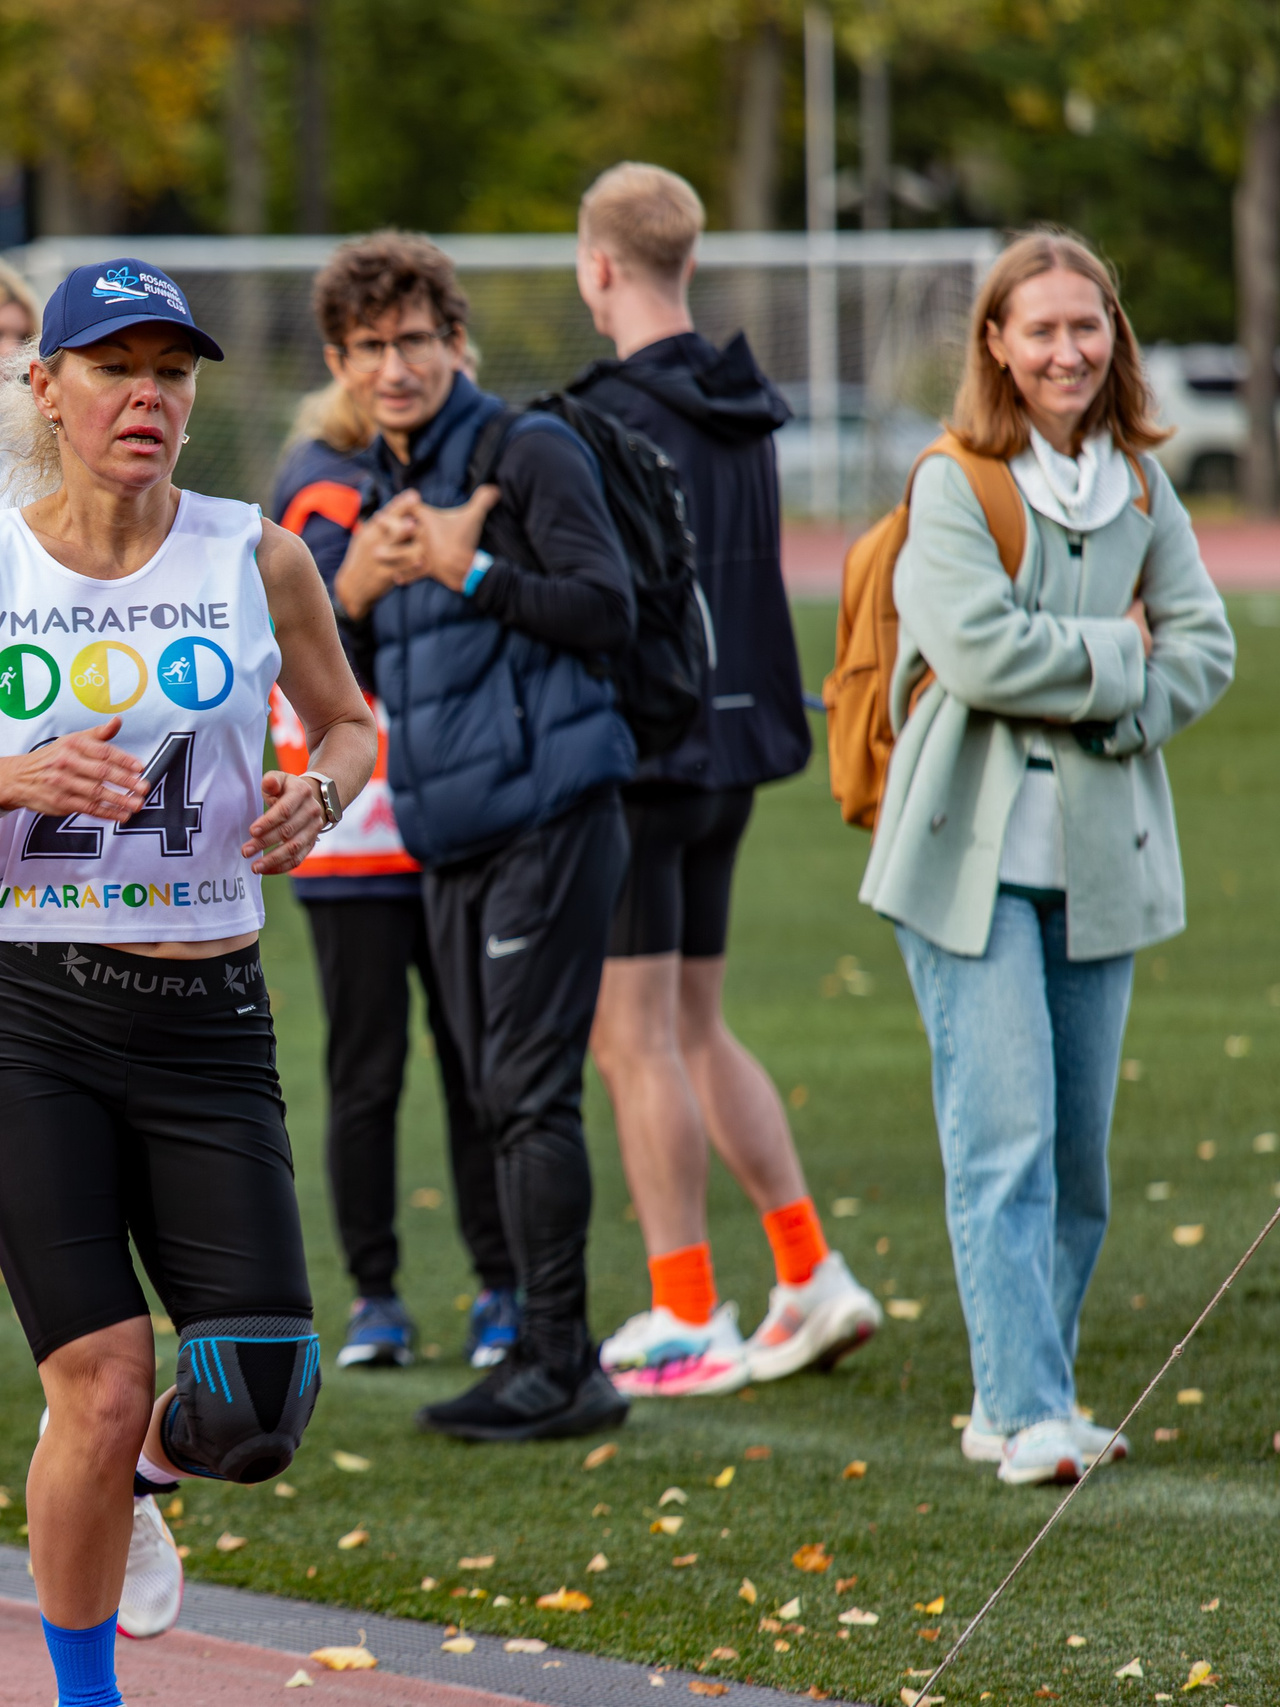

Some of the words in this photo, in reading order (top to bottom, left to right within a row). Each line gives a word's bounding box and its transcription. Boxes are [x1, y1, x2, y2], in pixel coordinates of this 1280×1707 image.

[139, 273, 179, 296] ROSATOM
[144, 283, 183, 306] RUNNING
[166, 299, 187, 315] CLUB
[20, 731, 204, 862] 24
